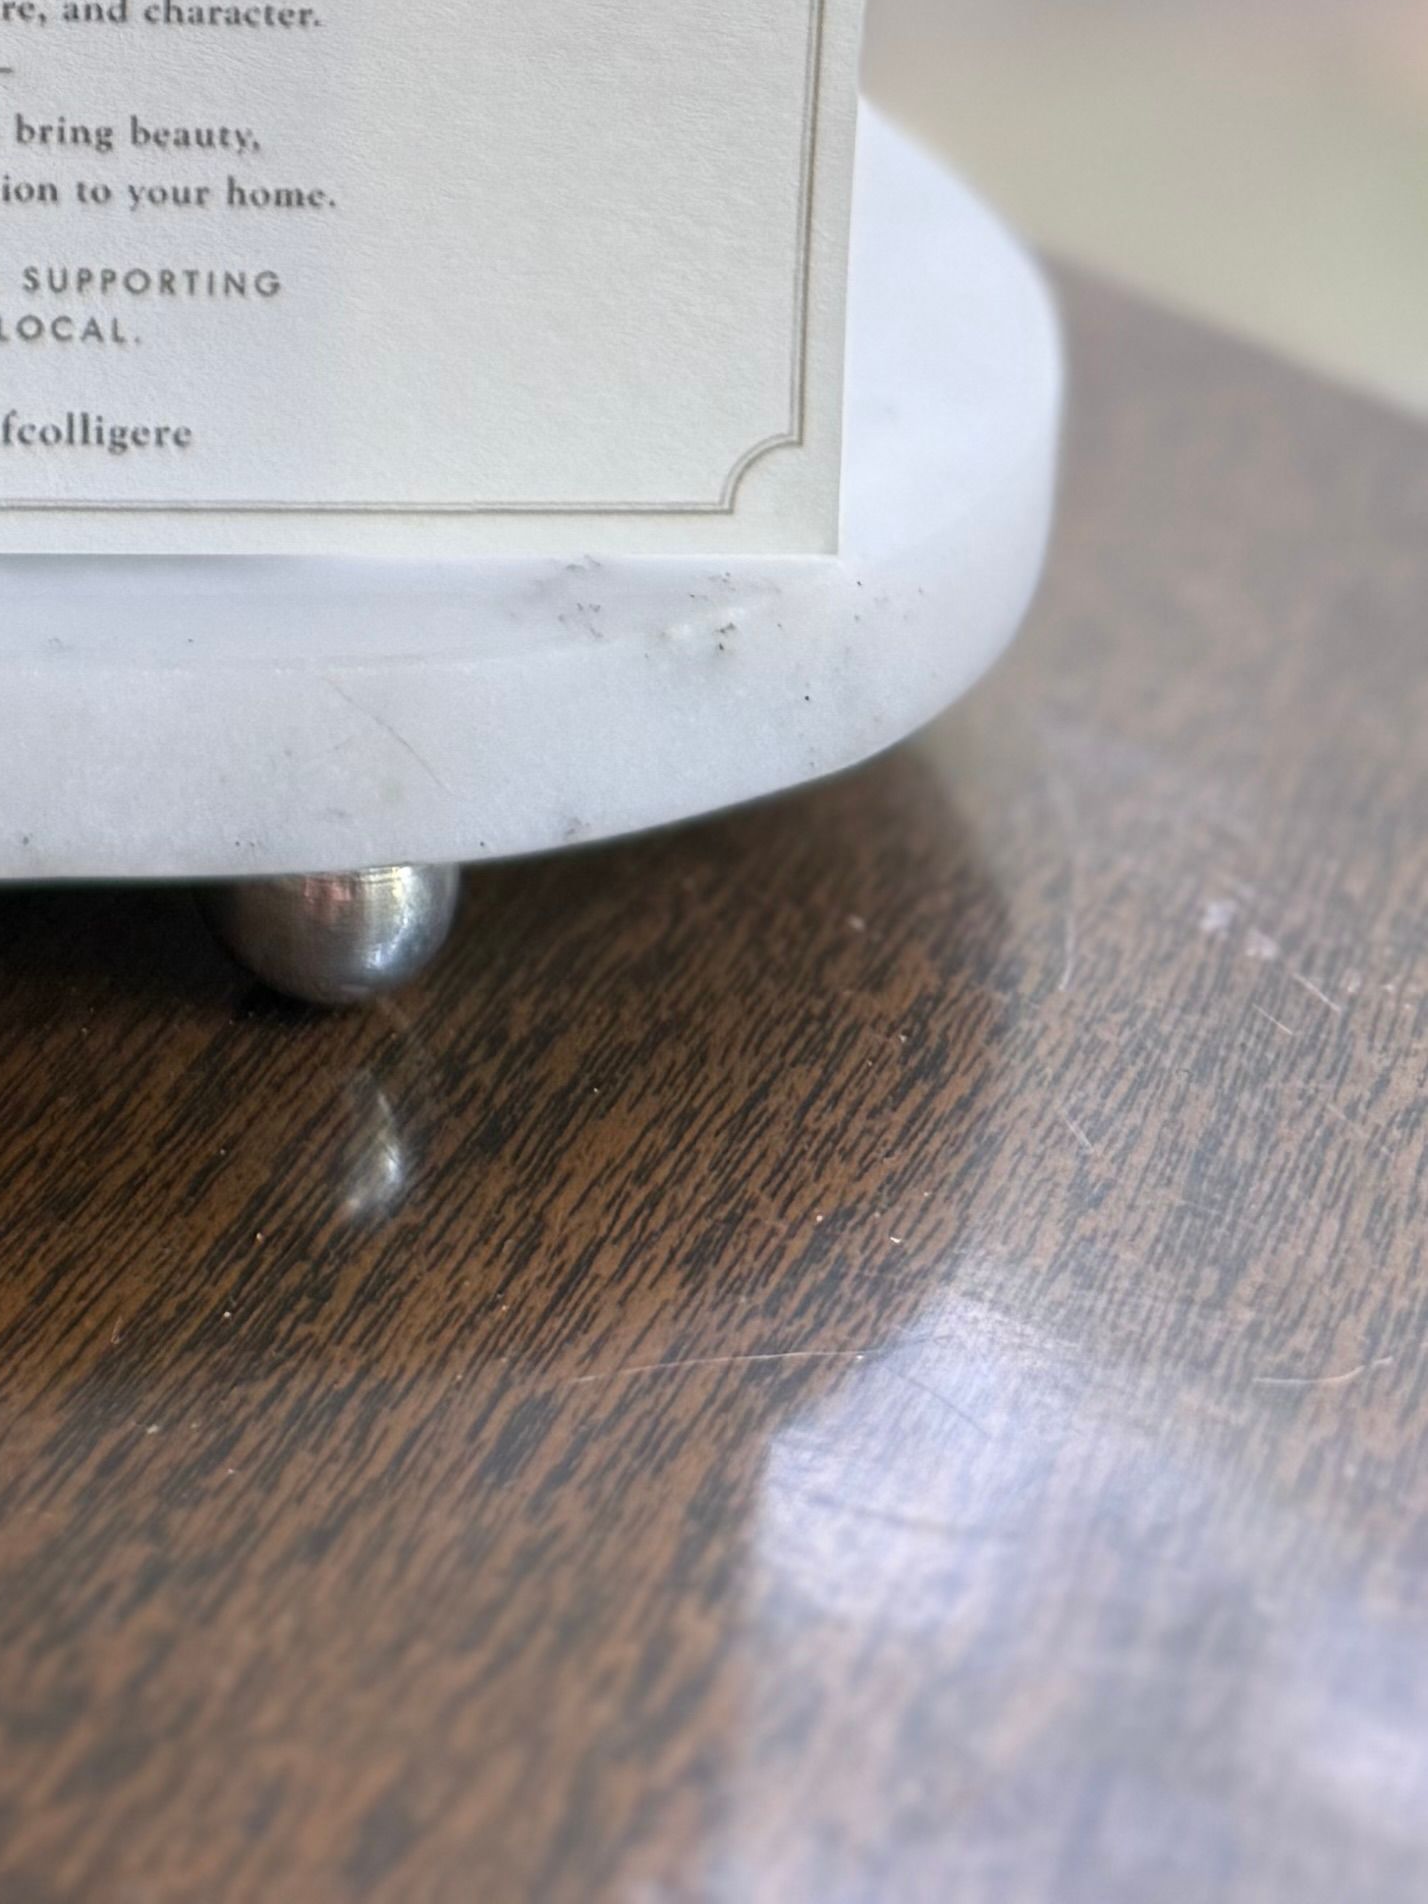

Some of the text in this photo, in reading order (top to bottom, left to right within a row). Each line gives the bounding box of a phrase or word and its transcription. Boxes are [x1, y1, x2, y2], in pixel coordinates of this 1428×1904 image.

[13, 111, 116, 157] bring
[128, 113, 263, 158] beauty,
[74, 179, 115, 208] to
[126, 183, 213, 214] your
[224, 173, 338, 212] home.
[20, 264, 284, 301] SUPPORTING
